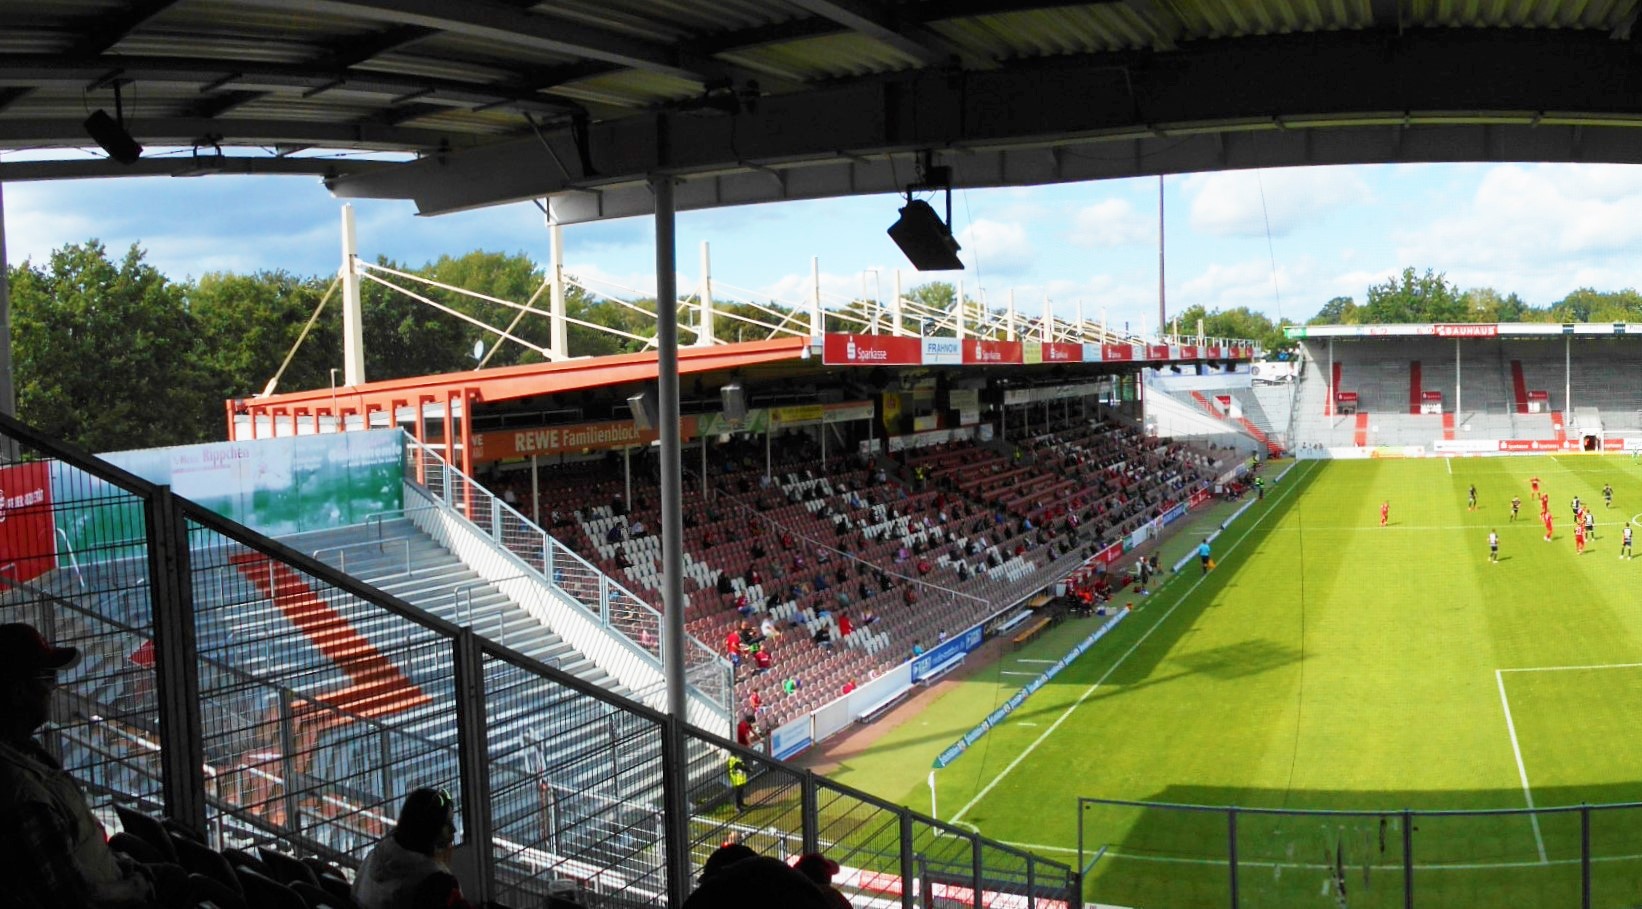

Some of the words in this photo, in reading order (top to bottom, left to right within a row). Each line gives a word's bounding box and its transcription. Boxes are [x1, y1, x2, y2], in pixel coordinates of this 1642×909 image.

[1445, 326, 1495, 336] BAUHAUS
[857, 348, 887, 361] Sparkasse
[515, 429, 559, 452] REWE
[563, 424, 640, 448] Familienblock
